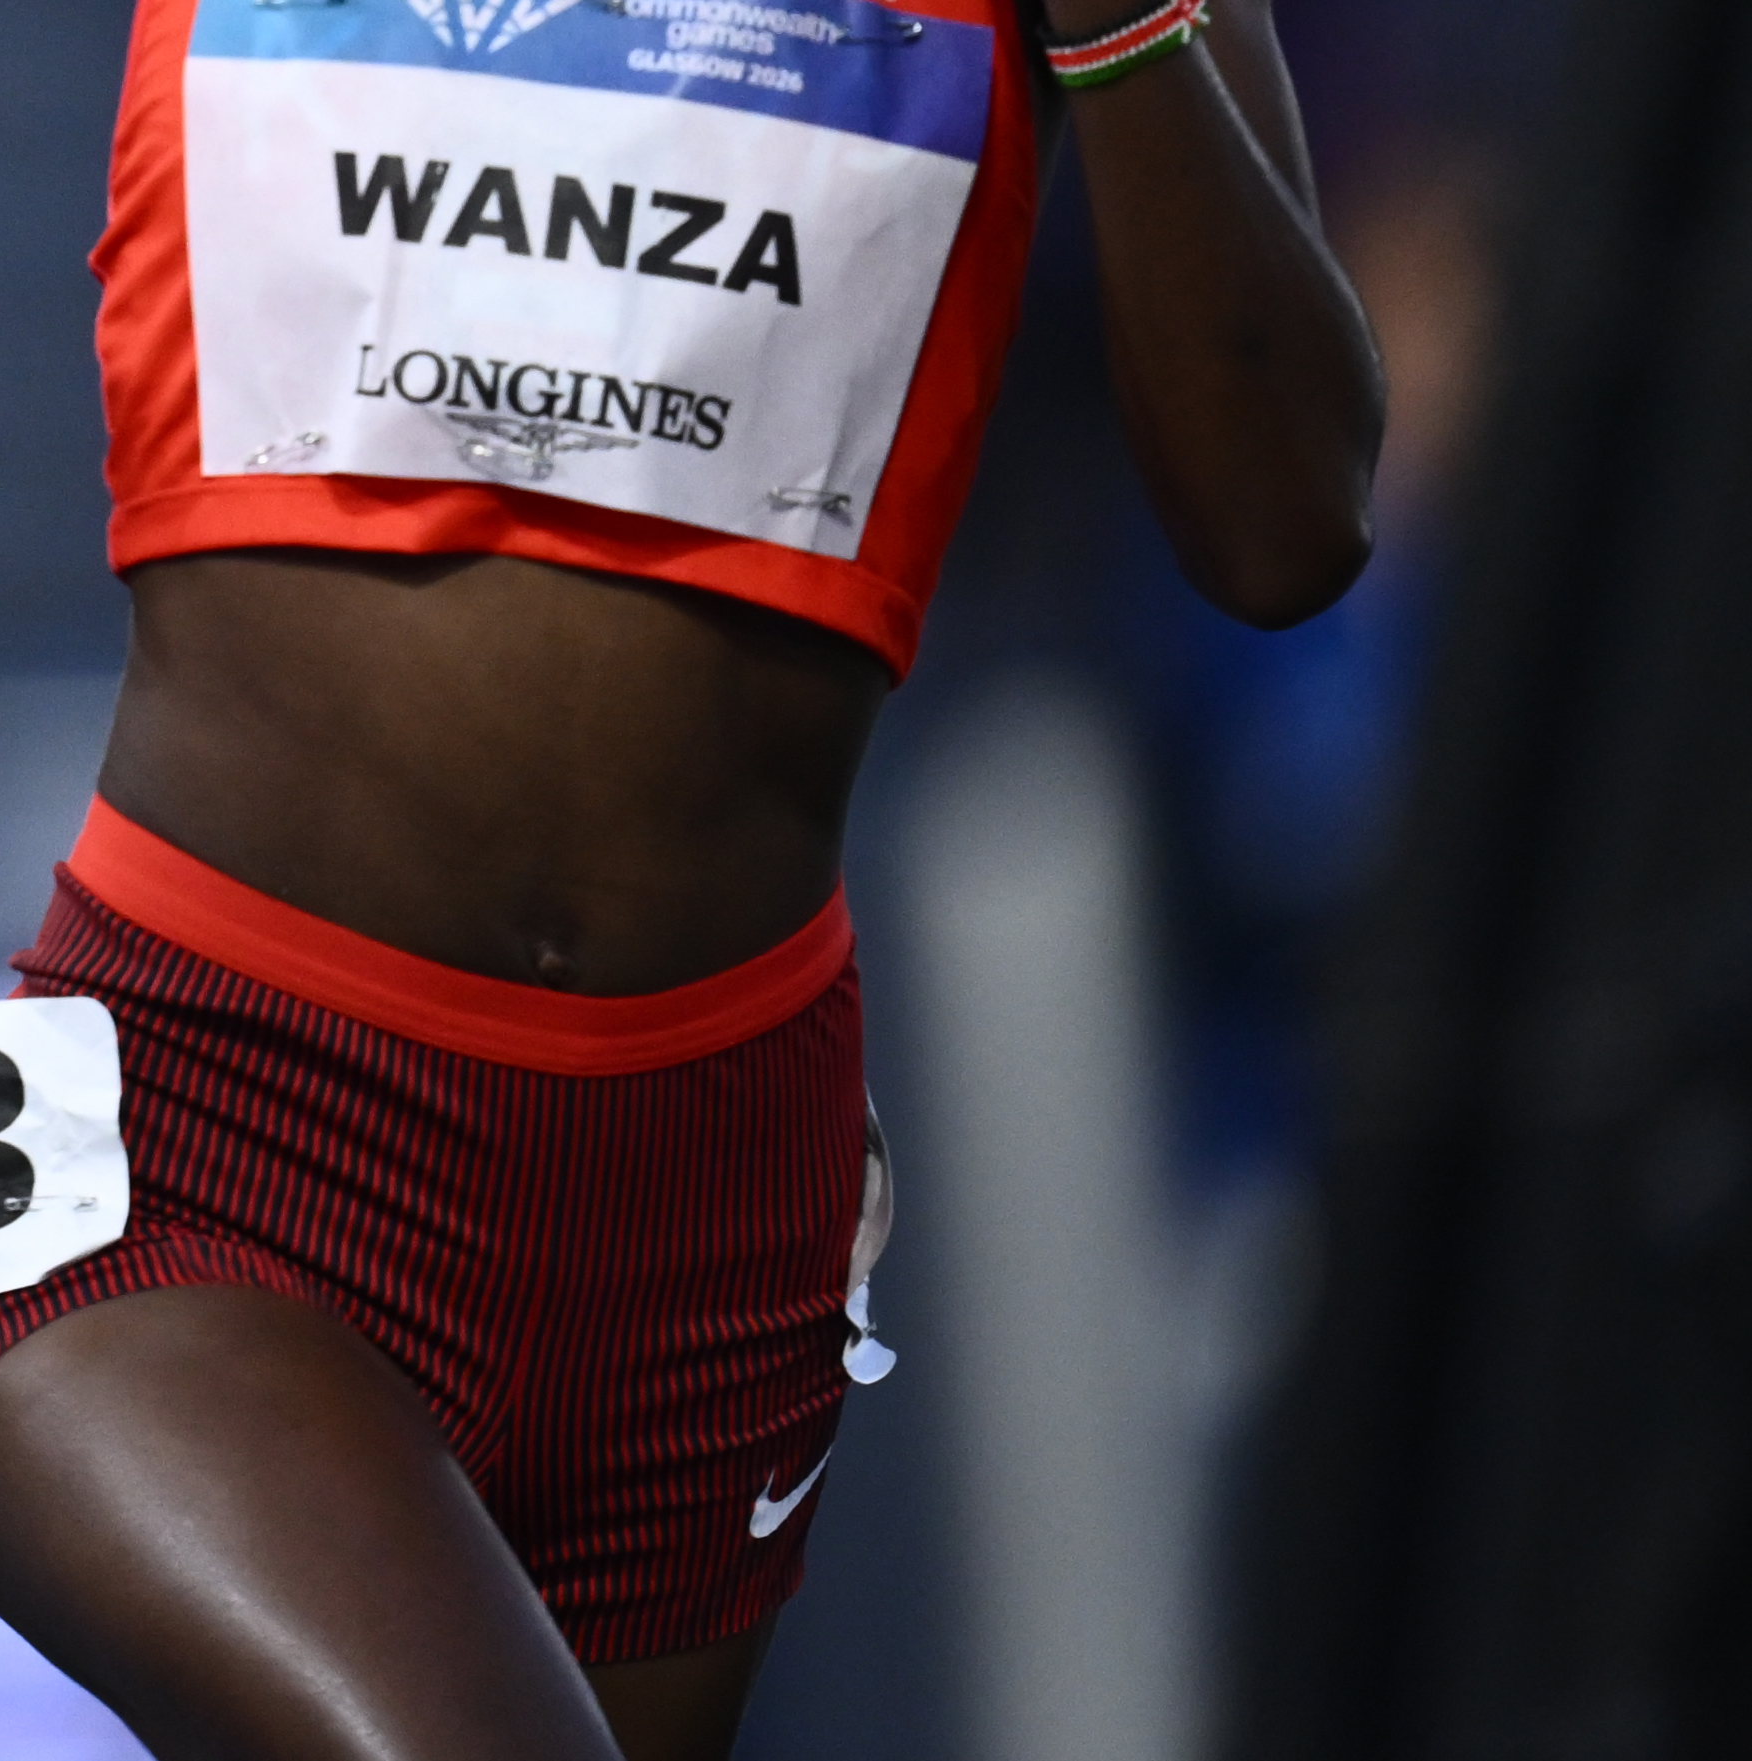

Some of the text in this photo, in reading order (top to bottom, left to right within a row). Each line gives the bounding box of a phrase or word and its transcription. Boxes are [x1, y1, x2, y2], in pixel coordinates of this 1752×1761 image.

[627, 47, 804, 94] GLASGOW 2026
[666, 20, 775, 56] games
[333, 149, 803, 307] WANZA
[354, 344, 733, 452] LONGINES
